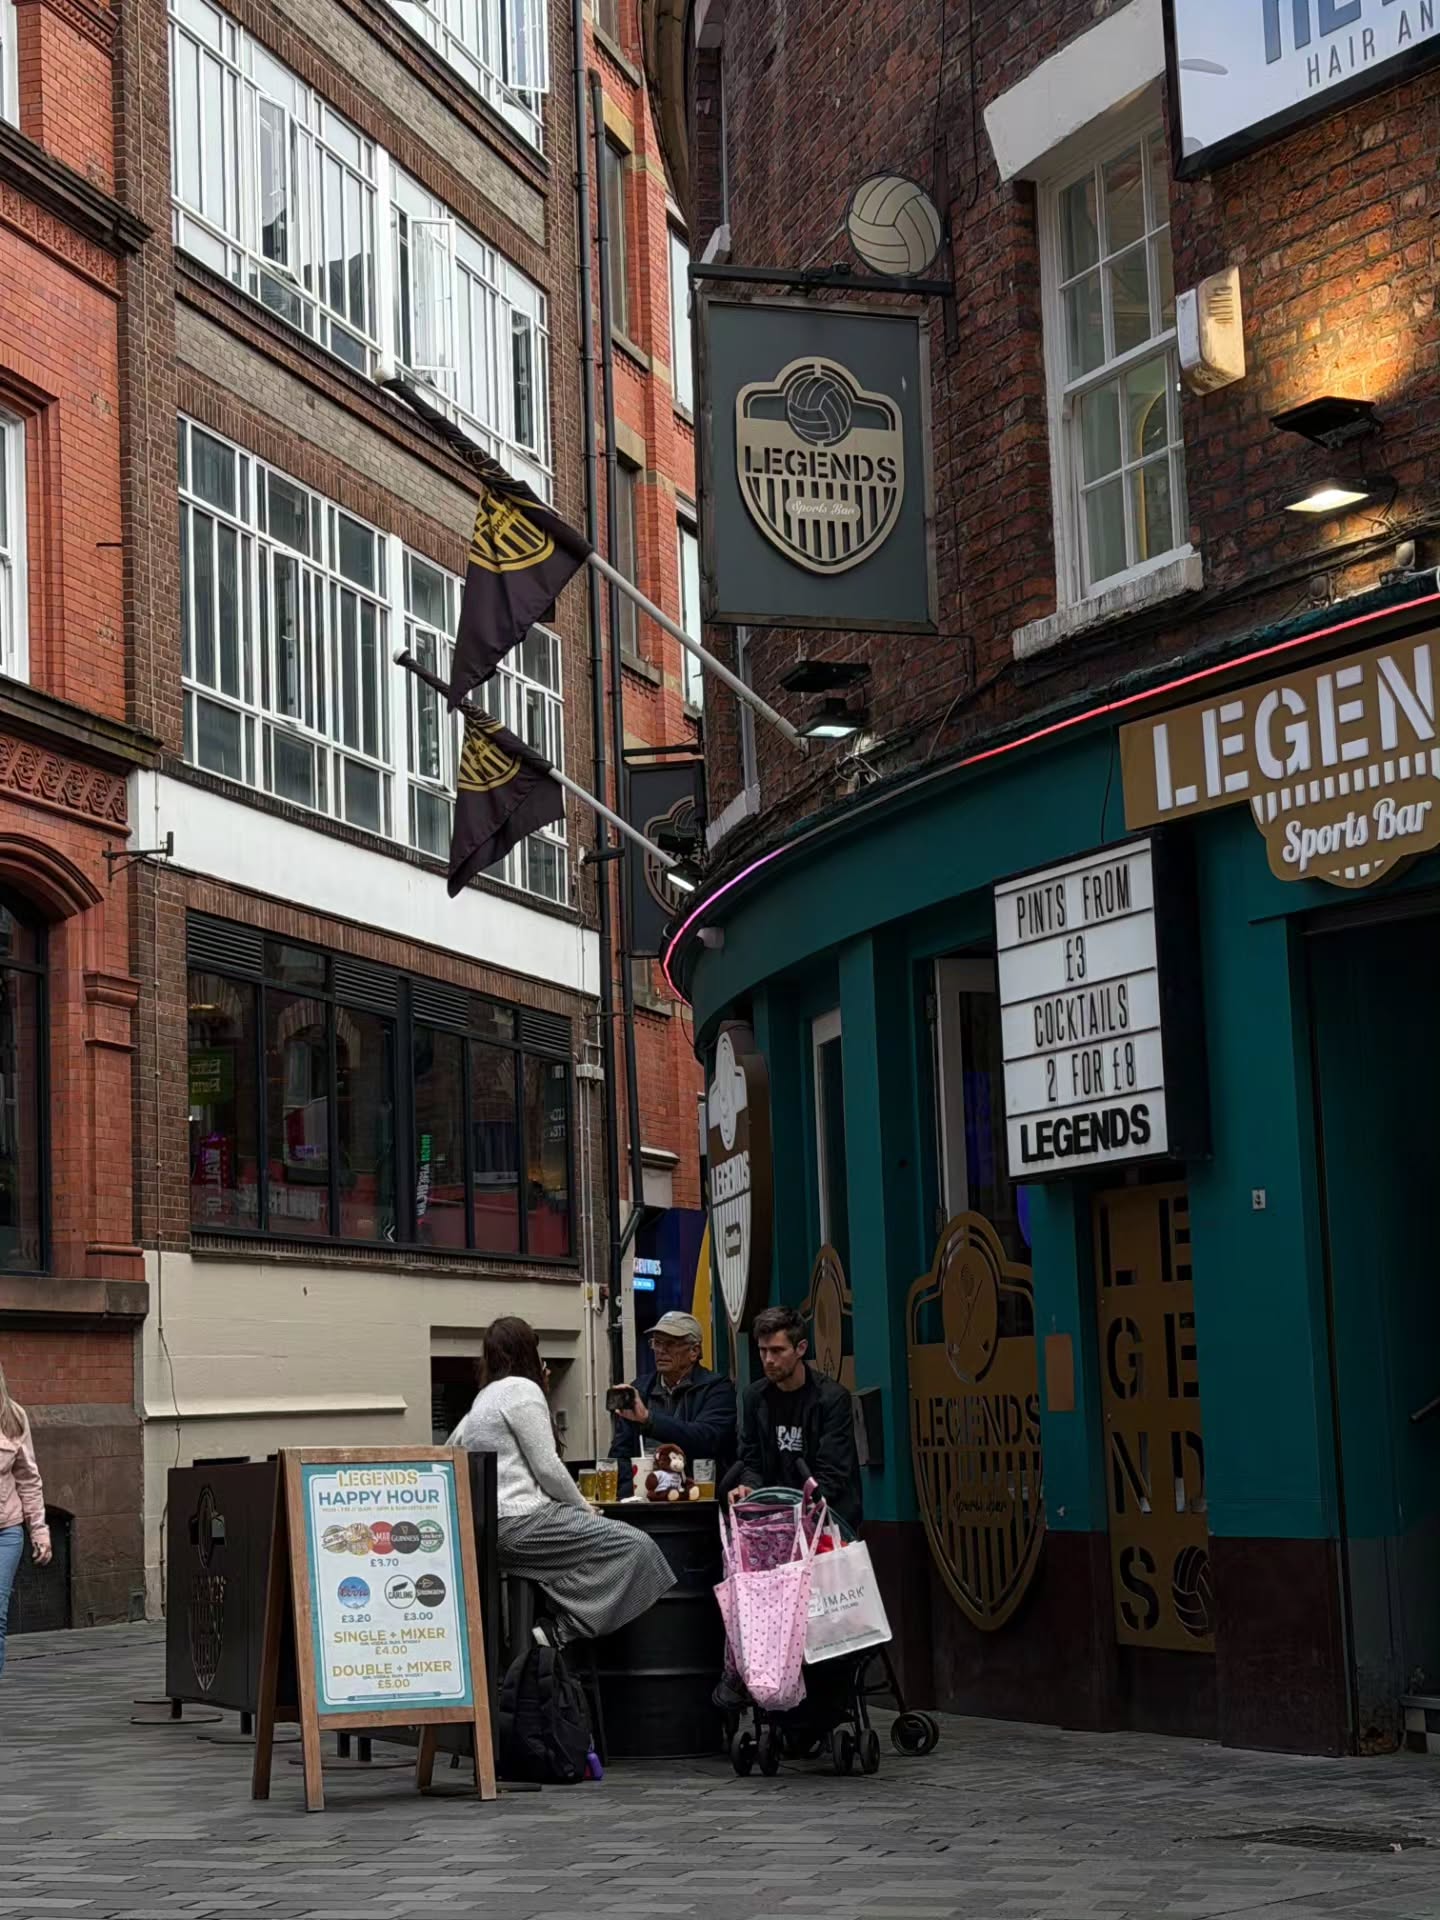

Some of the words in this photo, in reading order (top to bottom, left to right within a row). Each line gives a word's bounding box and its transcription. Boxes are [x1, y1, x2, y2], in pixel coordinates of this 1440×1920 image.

[1306, 27, 1376, 88] HAIR
[745, 445, 897, 484] LEGENDS
[791, 501, 828, 516] Sports
[831, 502, 855, 516] Bar
[1152, 643, 1436, 812] LEGEN
[1282, 811, 1369, 873] Sports
[1373, 797, 1433, 842] Bar
[1016, 883, 1066, 939] PINTS
[1081, 863, 1131, 921] FROM
[1065, 934, 1085, 983] £3
[1033, 983, 1128, 1048] COCKTAILS
[1047, 1058, 1057, 1102] 2
[1071, 1049, 1104, 1097] FOR
[1112, 1042, 1136, 1091] £8
[1020, 1103, 1151, 1164] LEGENDS
[913, 1393, 1042, 1447] LEGENDS
[338, 1470, 418, 1488] LEGENDS
[318, 1490, 382, 1506] HAPPY
[387, 1489, 440, 1504] HOUR
[370, 1558, 399, 1567] £3.70
[388, 1590, 414, 1600] CARLING
[822, 1585, 864, 1609] IMARK
[341, 1613, 371, 1623] £3.20
[403, 1611, 433, 1621] £3.00
[334, 1630, 386, 1643] SINGLE
[401, 1627, 445, 1640] MIXER
[375, 1645, 408, 1655] £4.00
[332, 1663, 392, 1677] DOUBLE
[407, 1660, 453, 1673] MIXER
[378, 1679, 410, 1689] £5.00
